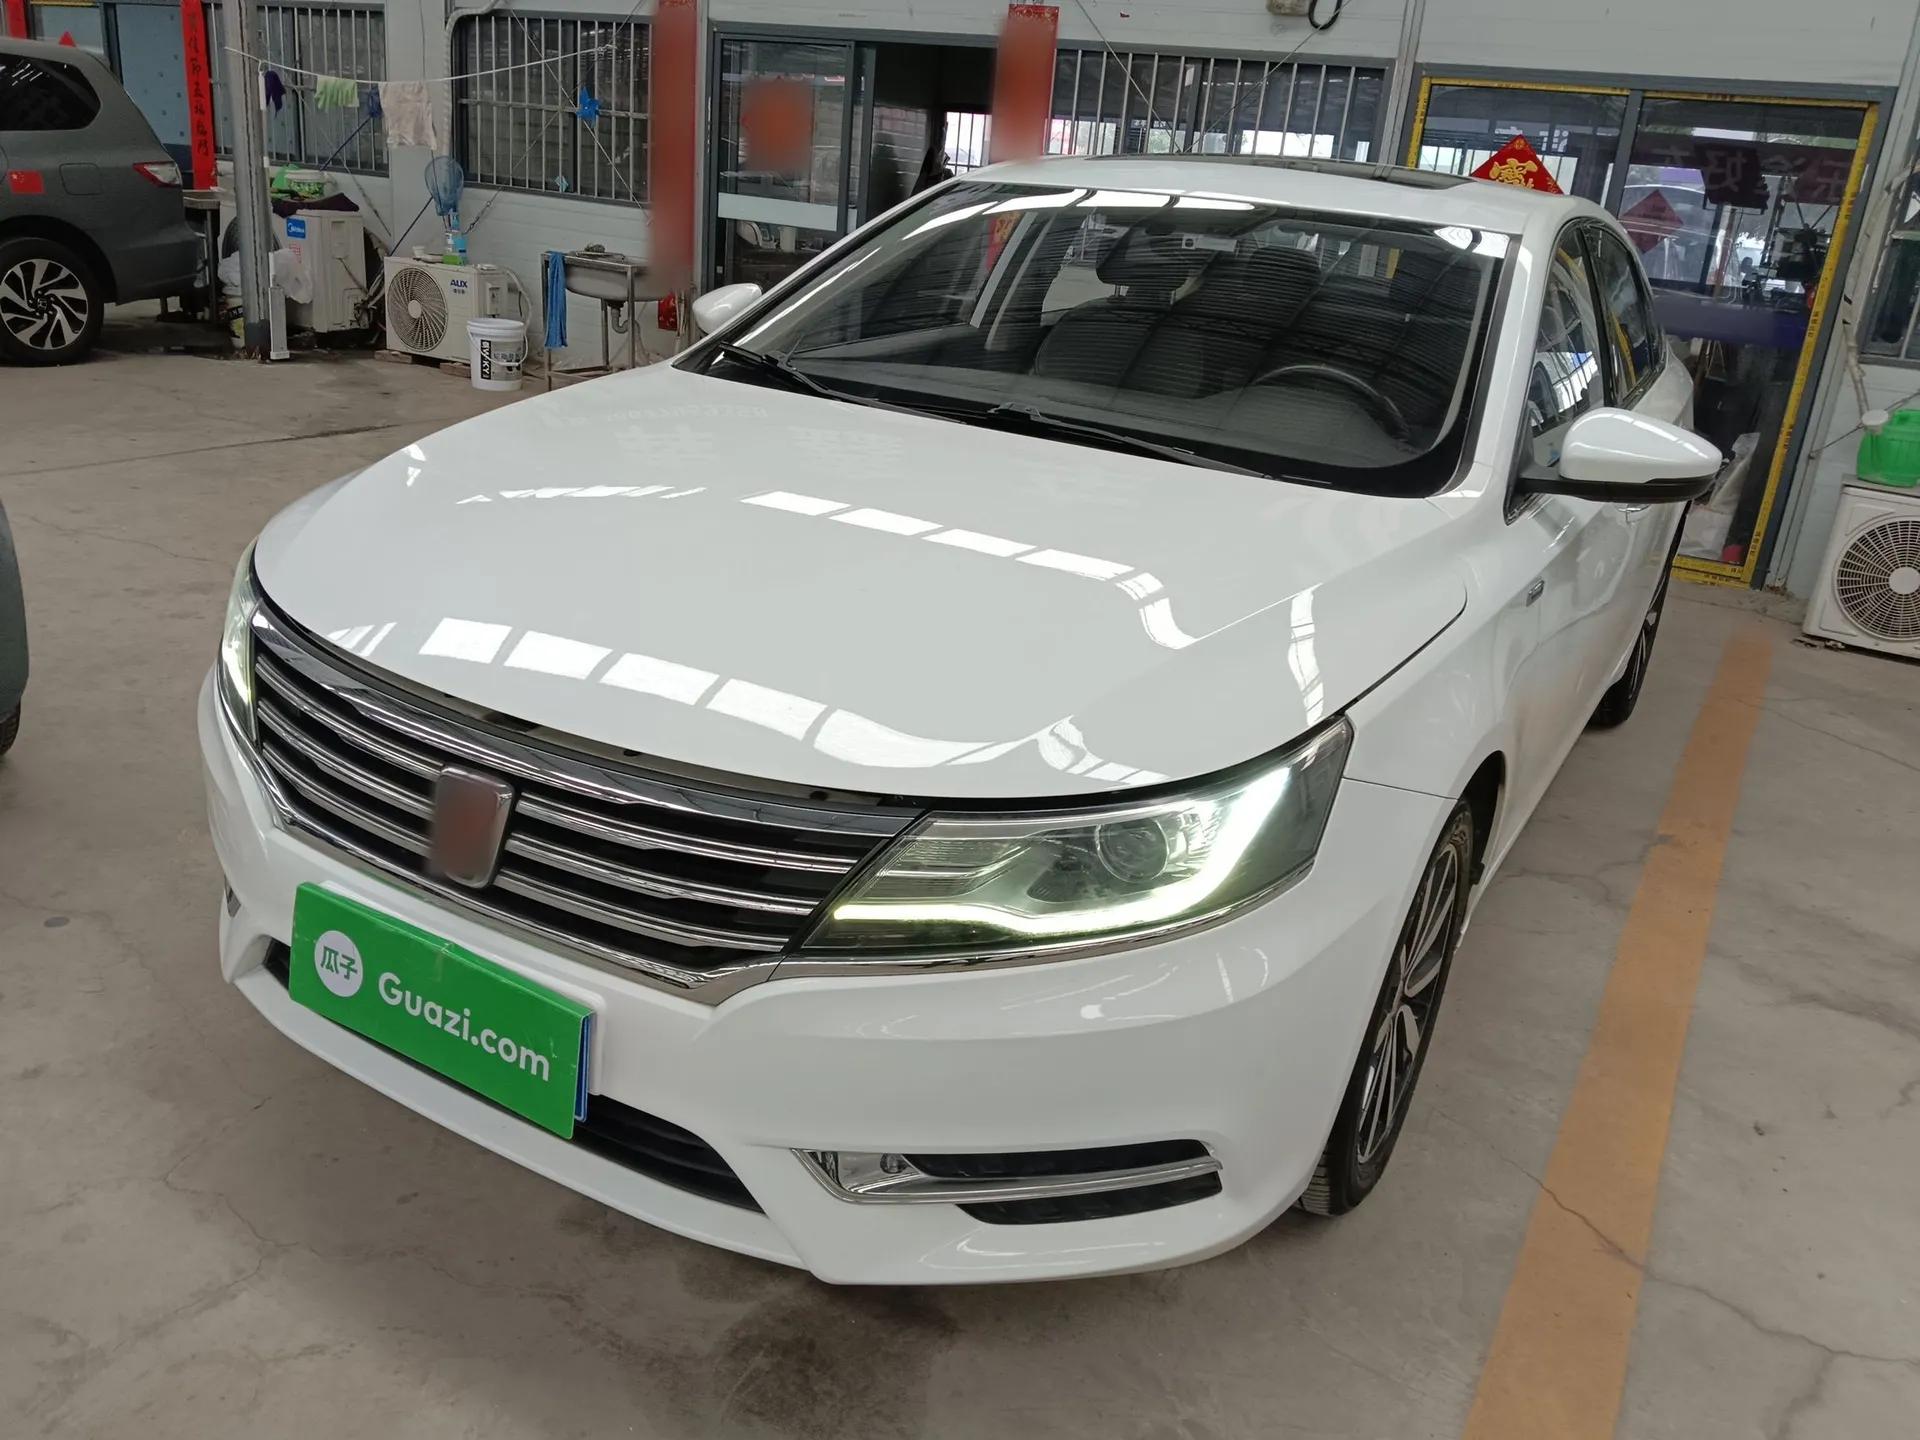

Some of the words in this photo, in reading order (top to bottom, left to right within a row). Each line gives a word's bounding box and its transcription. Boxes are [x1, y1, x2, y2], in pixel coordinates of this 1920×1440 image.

[451, 280, 468, 288] AUX
[320, 946, 358, 980] 瓜子
[379, 972, 550, 1081] Guazi.com
